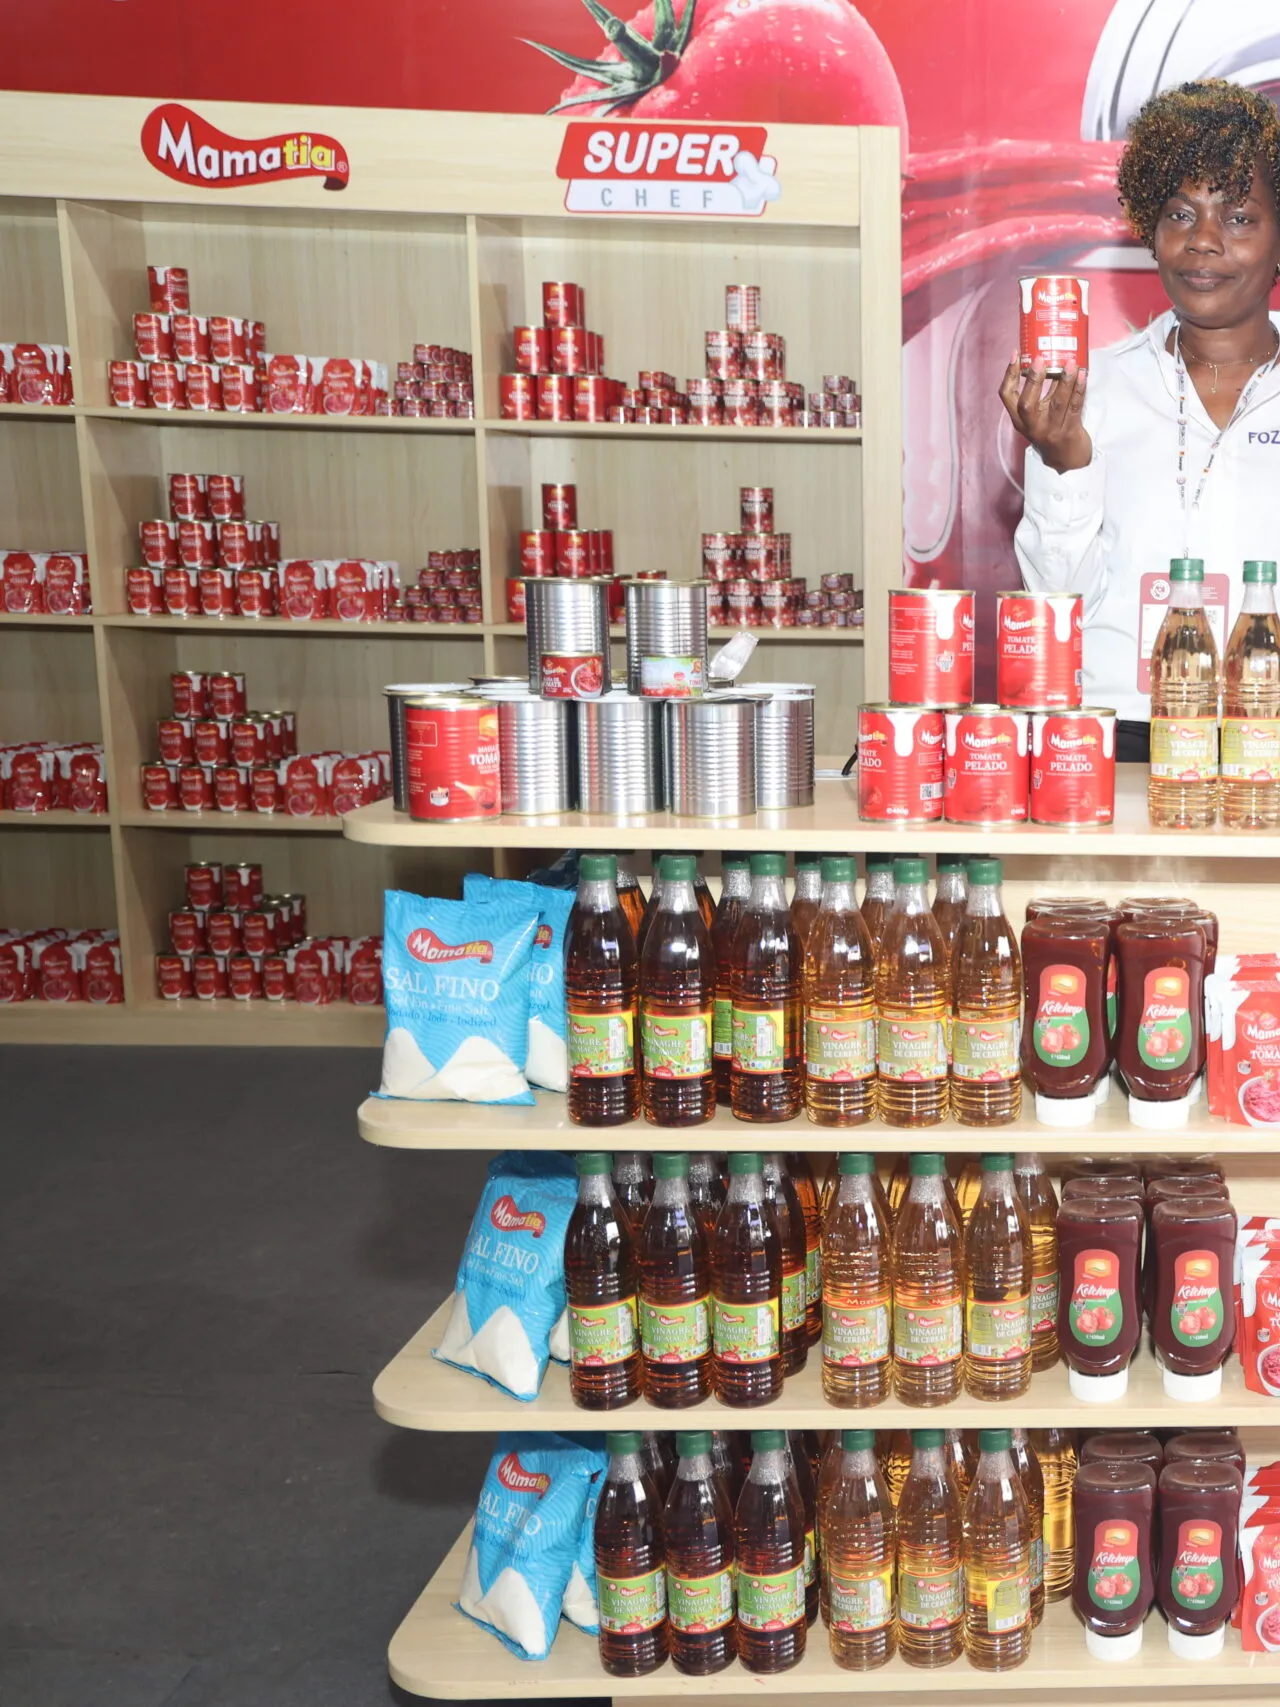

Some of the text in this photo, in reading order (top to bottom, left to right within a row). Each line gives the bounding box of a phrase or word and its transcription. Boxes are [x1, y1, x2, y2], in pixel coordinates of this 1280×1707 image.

[158, 117, 335, 179] Mamatia
[584, 130, 739, 176] SUPER
[601, 188, 713, 209] CHEF
[1004, 644, 1040, 654] PELADO
[965, 761, 1007, 771] PELADO
[970, 753, 1002, 761] TOMATE
[1050, 762, 1092, 772] PELADO
[1055, 754, 1087, 762] TOMATE
[412, 933, 488, 960] Mamatia
[385, 967, 427, 994] SAL
[435, 975, 500, 1002] FINO
[494, 1200, 541, 1227] Mamatia
[492, 1241, 539, 1274] FINO
